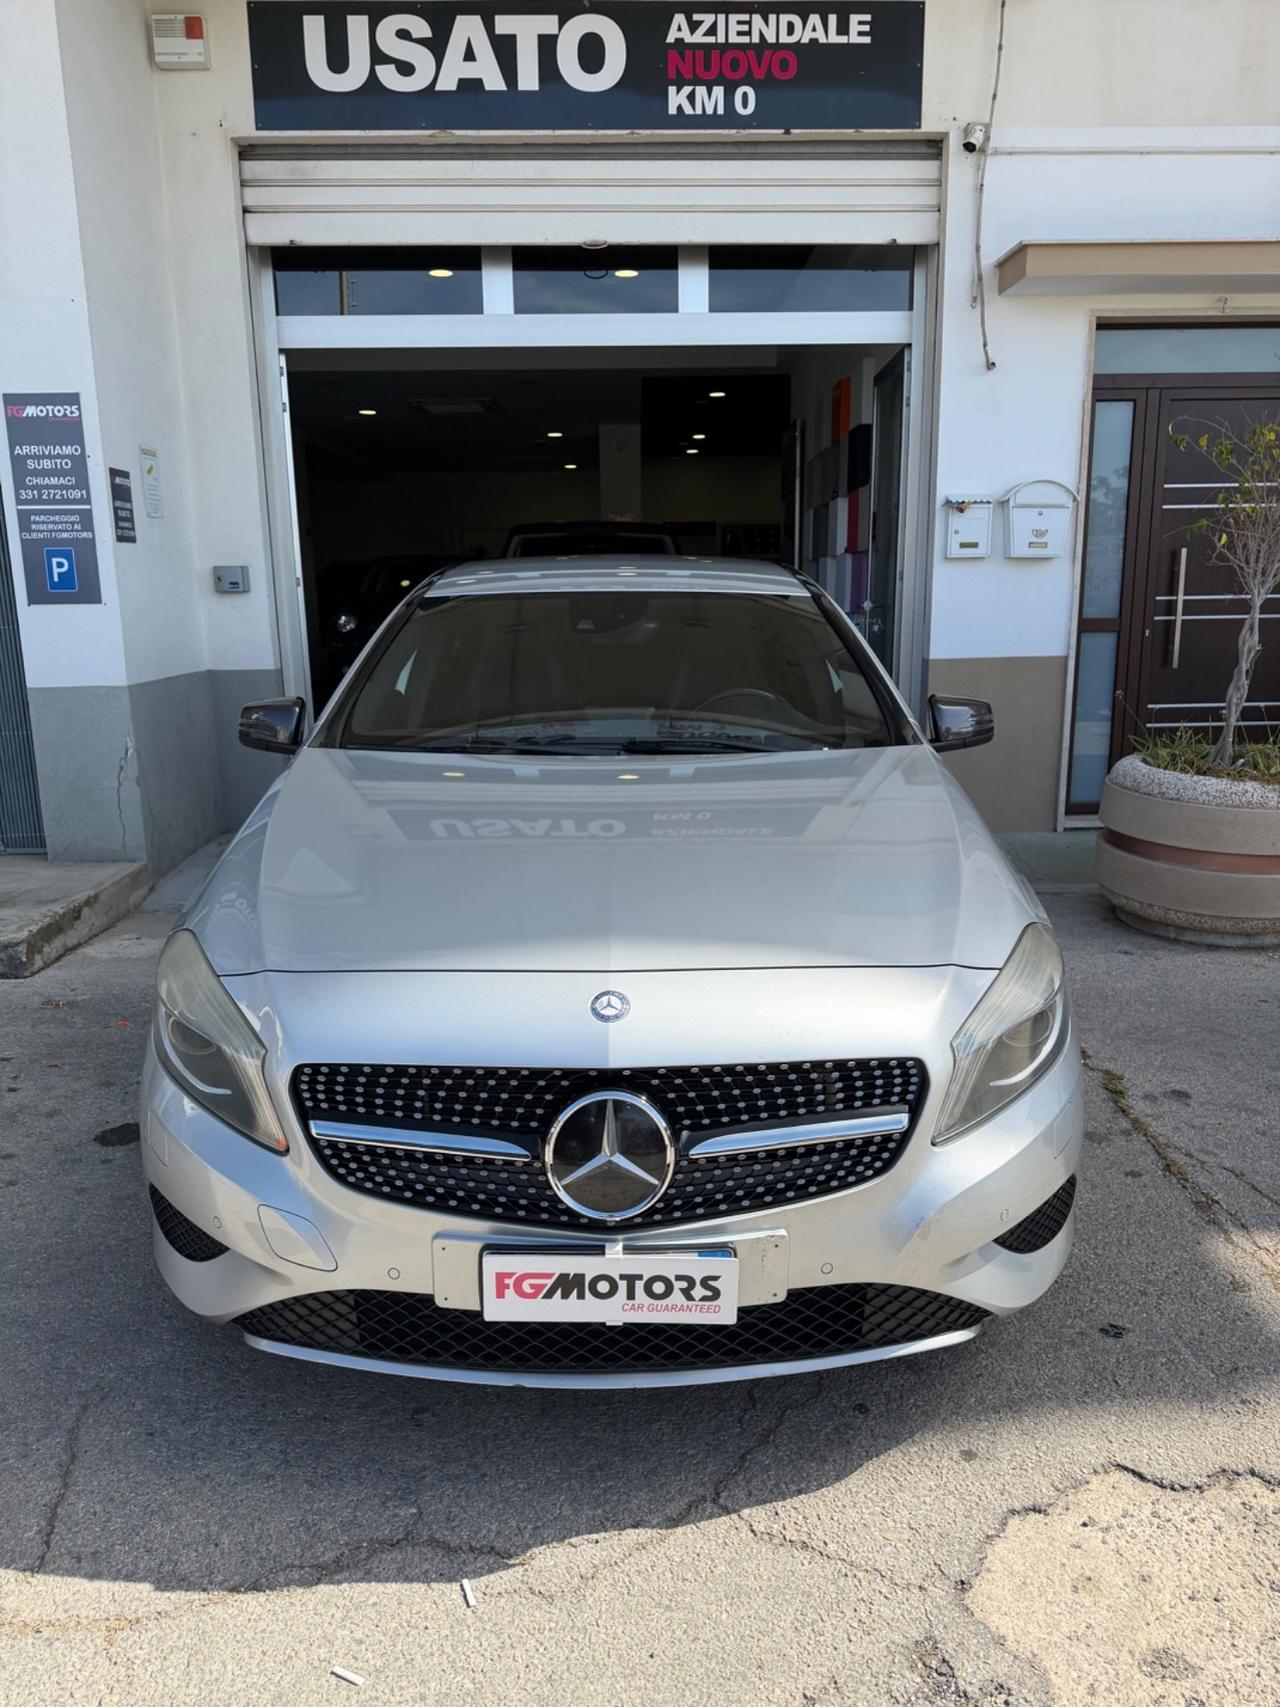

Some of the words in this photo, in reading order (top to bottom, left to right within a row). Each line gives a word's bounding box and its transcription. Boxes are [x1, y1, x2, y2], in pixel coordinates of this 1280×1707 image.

[665, 13, 872, 44] AZIENDALE
[302, 13, 627, 92] USATO
[666, 49, 798, 80] NUOVO
[667, 85, 725, 115] KM
[733, 86, 757, 115] 0
[6, 405, 80, 417] FGMOTORS
[14, 445, 81, 456] ARRIVIAMO
[26, 459, 72, 469] SUBITO
[25, 476, 76, 485] CHIAMACI
[19, 489, 39, 499] 331
[41, 489, 87, 499] 2721091
[52, 531, 93, 539] FGMOTORS
[51, 557, 69, 582] P
[494, 1271, 723, 1302] FGMOTORS
[621, 1302, 646, 1313] CAR
[647, 1302, 722, 1314] GUARANTEED
